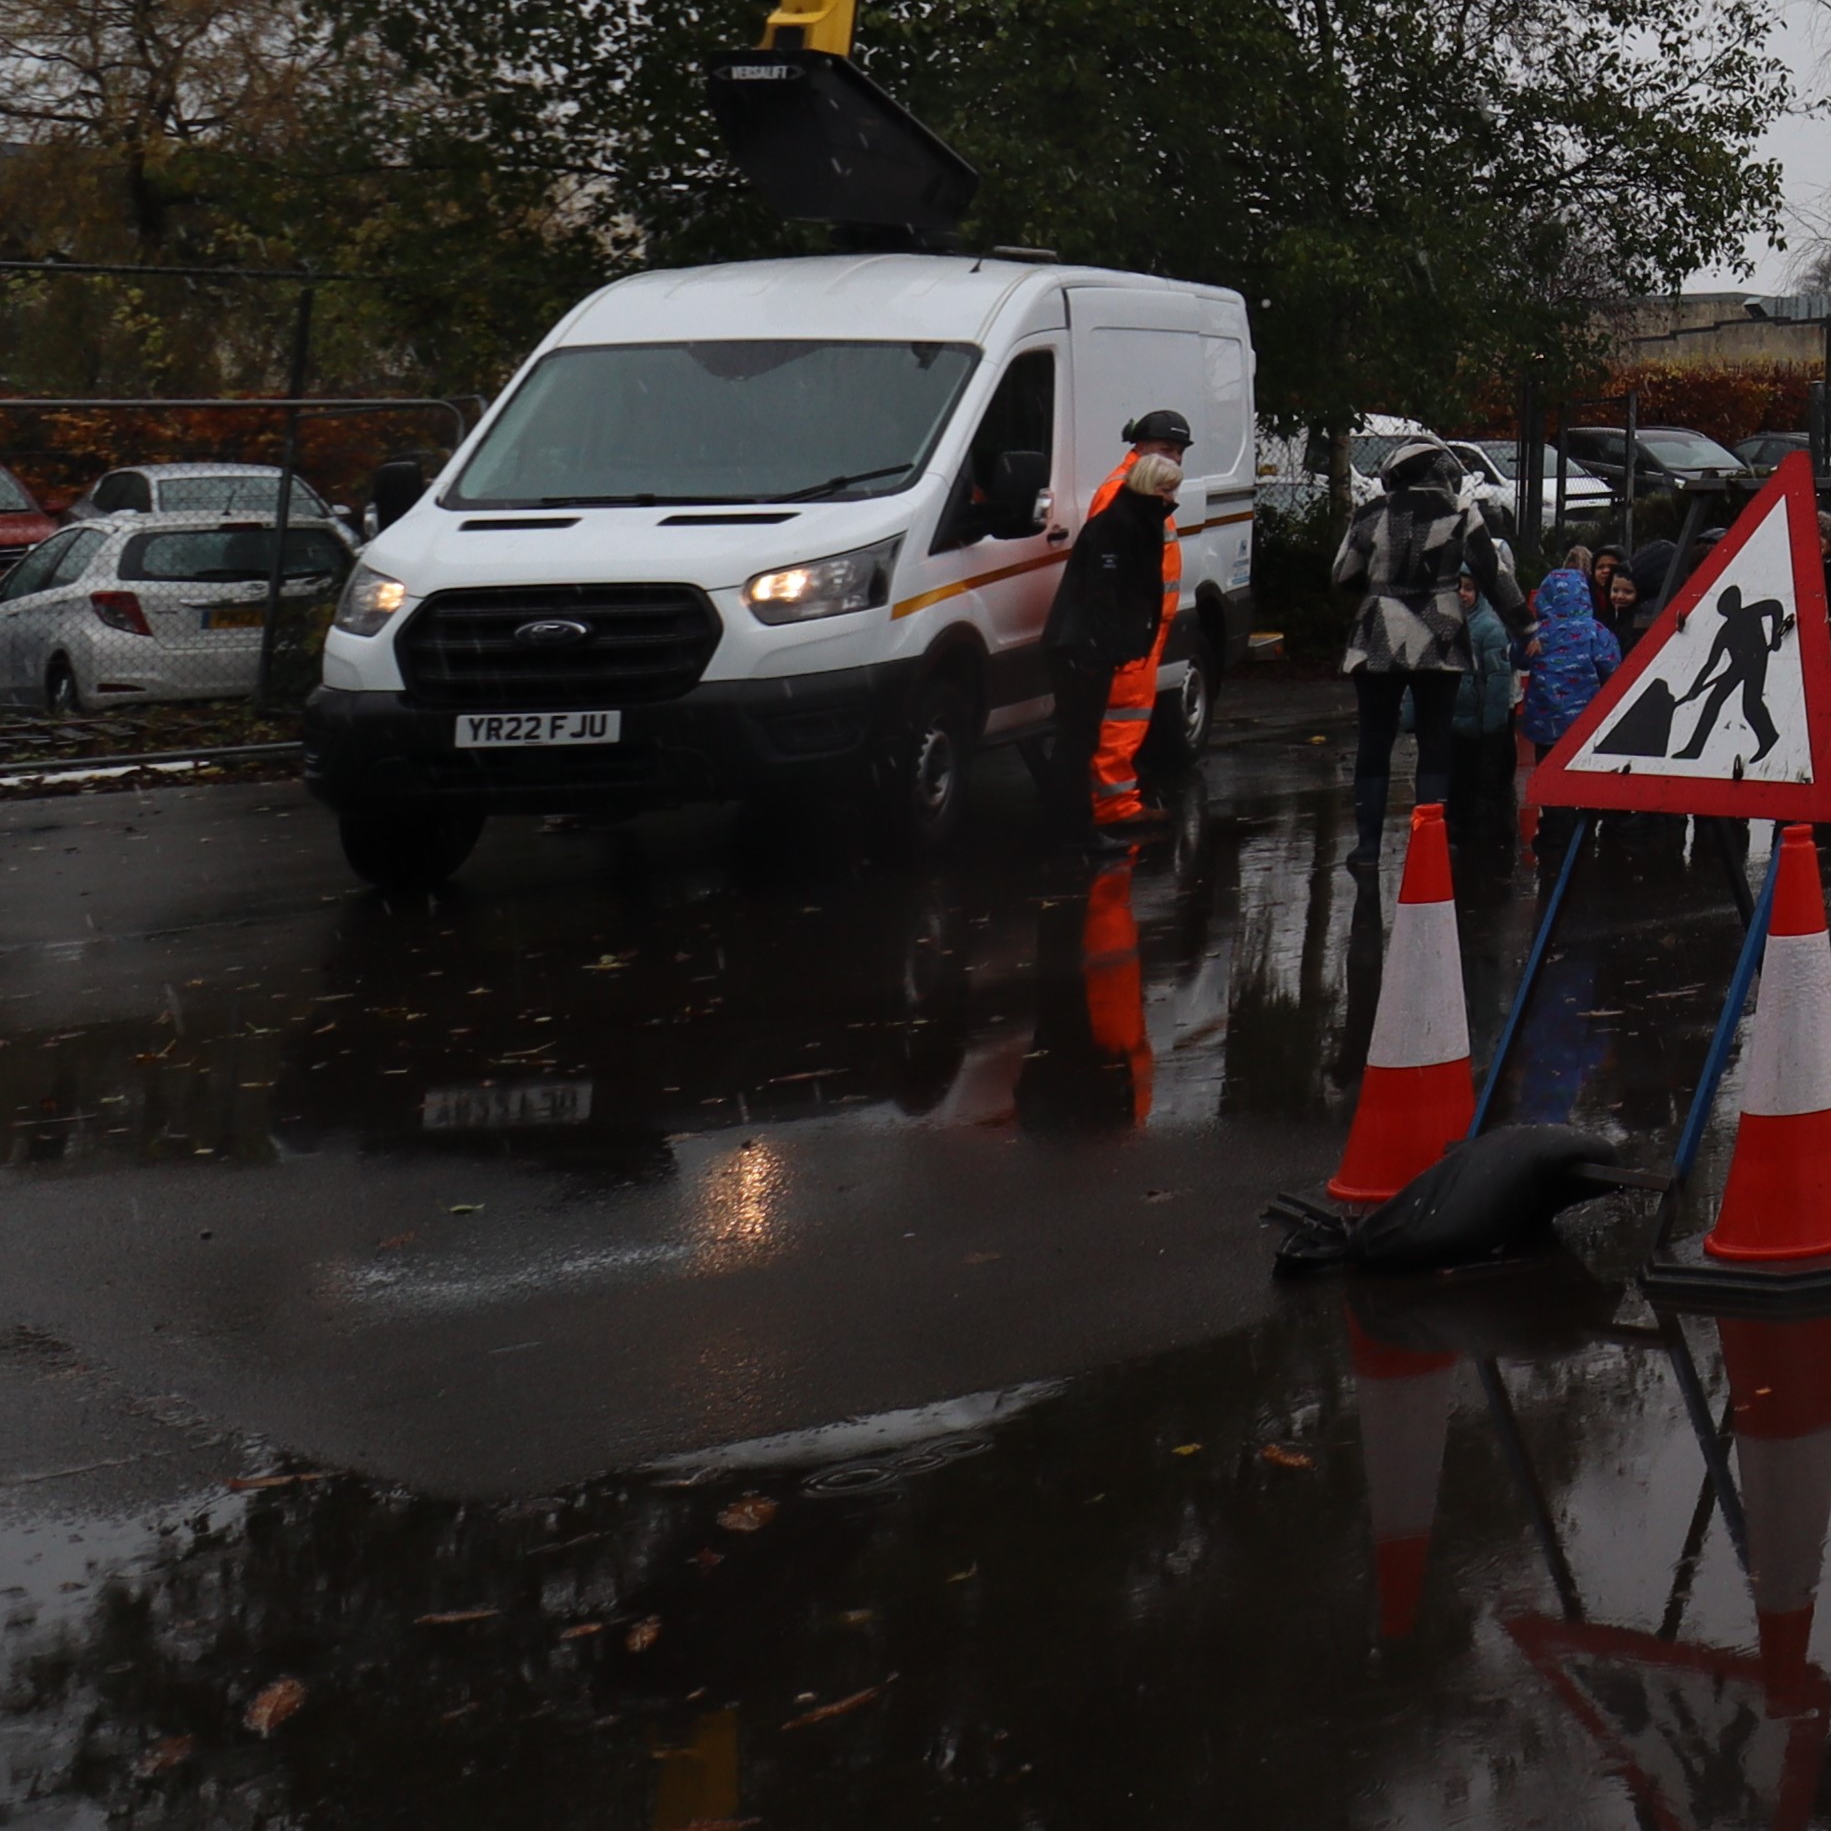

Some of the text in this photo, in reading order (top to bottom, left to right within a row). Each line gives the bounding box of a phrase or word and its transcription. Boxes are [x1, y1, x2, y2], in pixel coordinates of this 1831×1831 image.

[731, 65, 788, 80] VERSALIFT
[468, 713, 607, 741] YR22 FJU
